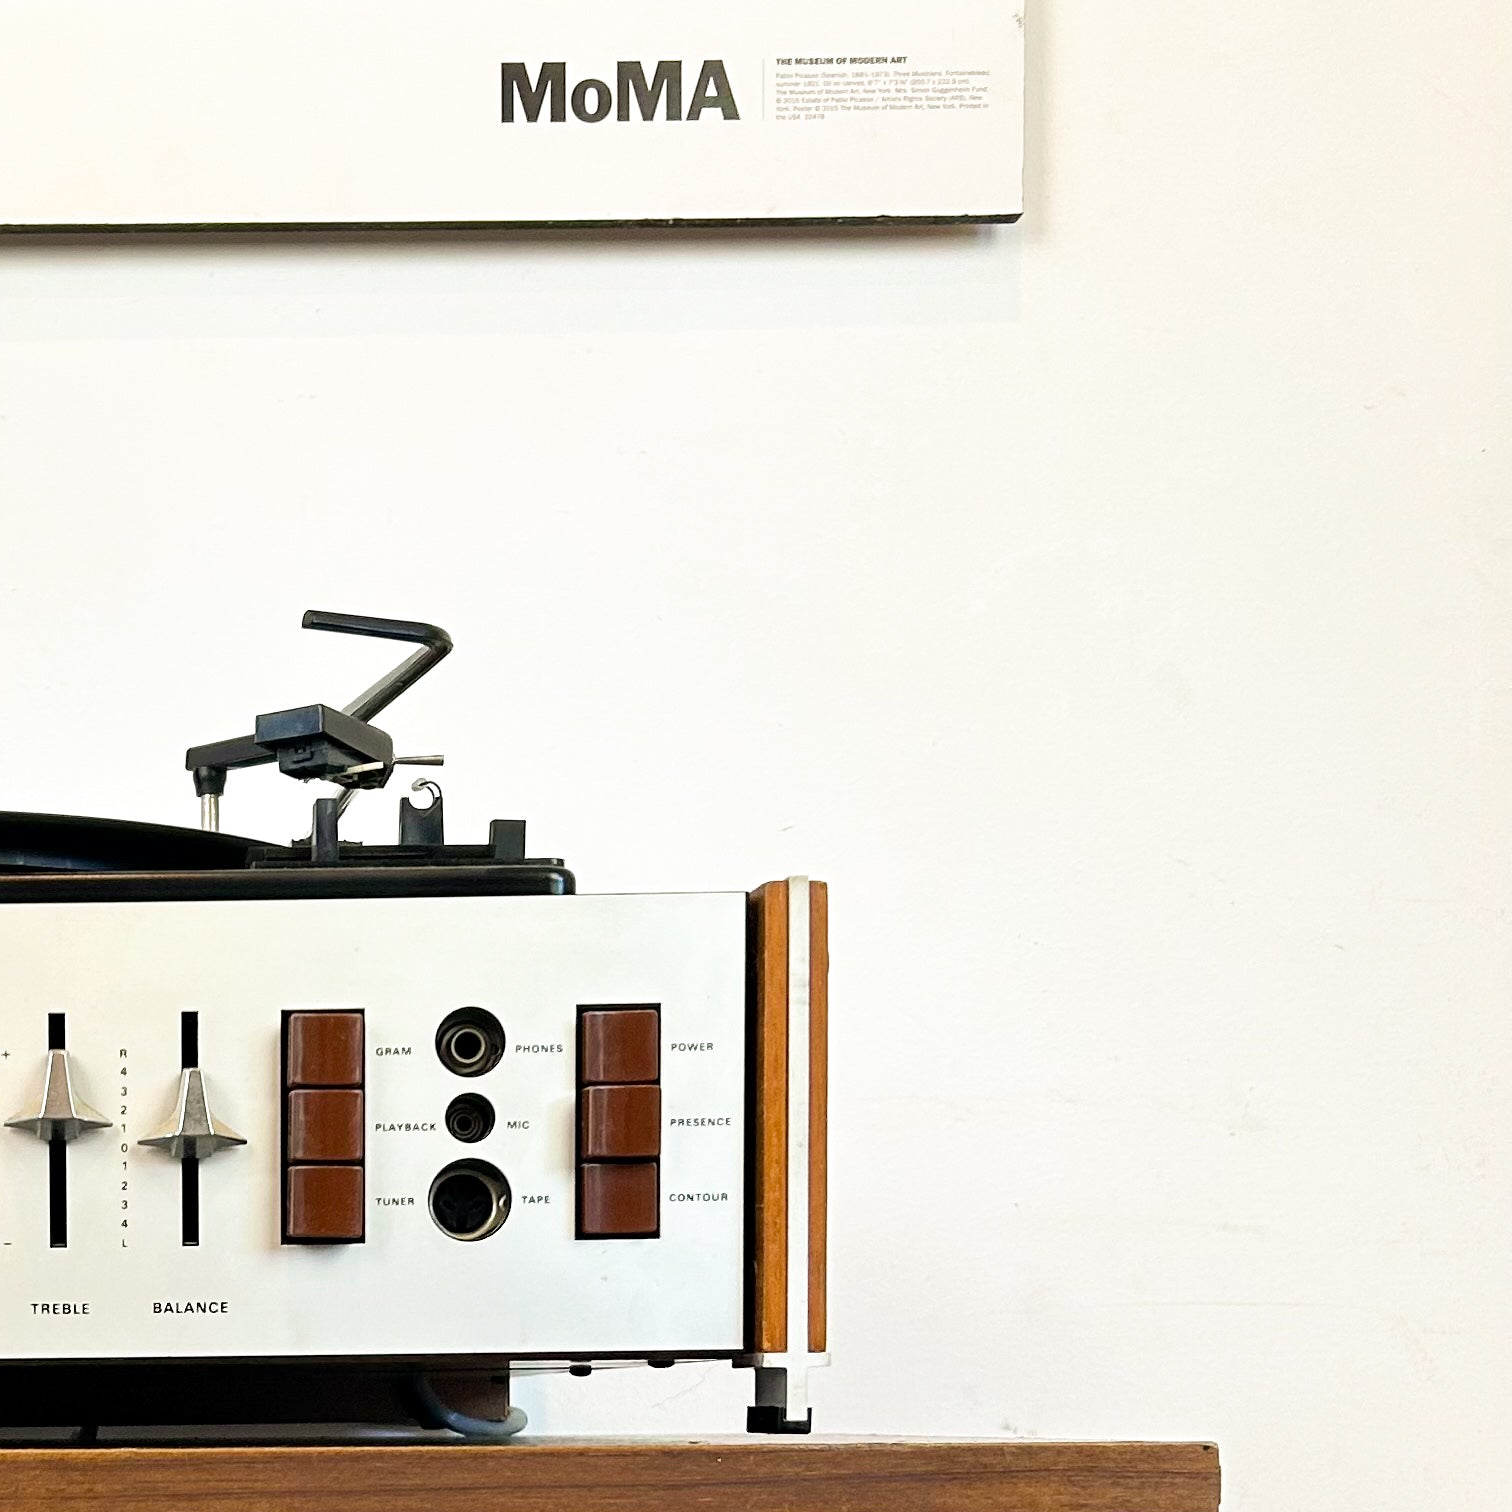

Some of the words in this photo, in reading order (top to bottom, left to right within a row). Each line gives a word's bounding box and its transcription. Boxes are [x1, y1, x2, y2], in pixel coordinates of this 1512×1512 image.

[775, 57, 793, 66] THE
[794, 57, 834, 66] MUSEUM
[835, 57, 848, 65] OF
[849, 56, 888, 65] MODERN
[889, 56, 908, 64] ART
[501, 60, 740, 123] MoMA
[375, 1046, 412, 1057] GRAM
[515, 1043, 564, 1054] PHONES
[670, 1042, 714, 1052] POWER
[375, 1122, 436, 1132] PLAYBACK
[506, 1120, 530, 1130] MIC
[669, 1117, 732, 1127] PRESENCE
[374, 1196, 415, 1207] TUNER
[521, 1195, 550, 1204] TAPE
[668, 1192, 728, 1202] CONTOUR
[30, 1303, 90, 1315] TREBLE
[153, 1301, 229, 1314] BALANCE
